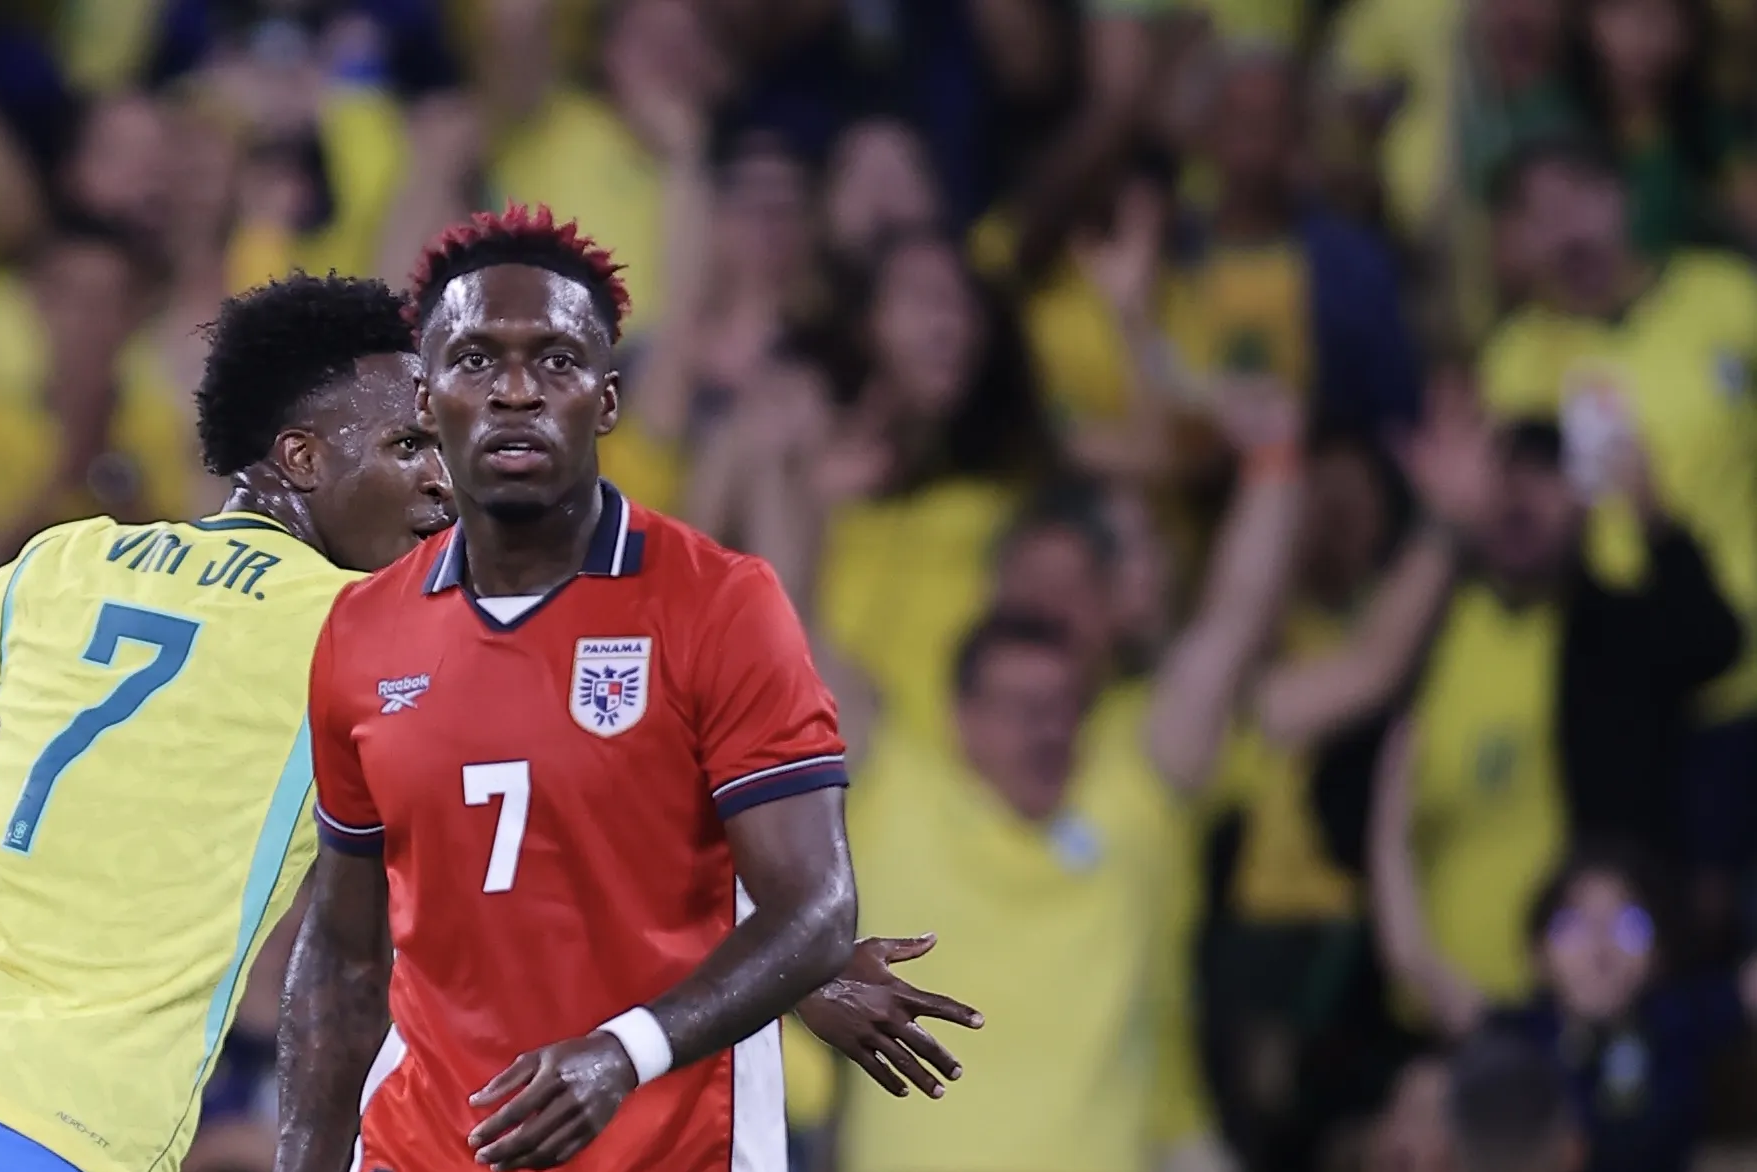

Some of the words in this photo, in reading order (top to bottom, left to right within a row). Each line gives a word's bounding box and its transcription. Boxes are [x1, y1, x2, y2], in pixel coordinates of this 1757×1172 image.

[197, 539, 282, 601] JR.
[1, 602, 204, 855] 7
[377, 673, 430, 696] Reebok
[462, 760, 530, 893] 7
